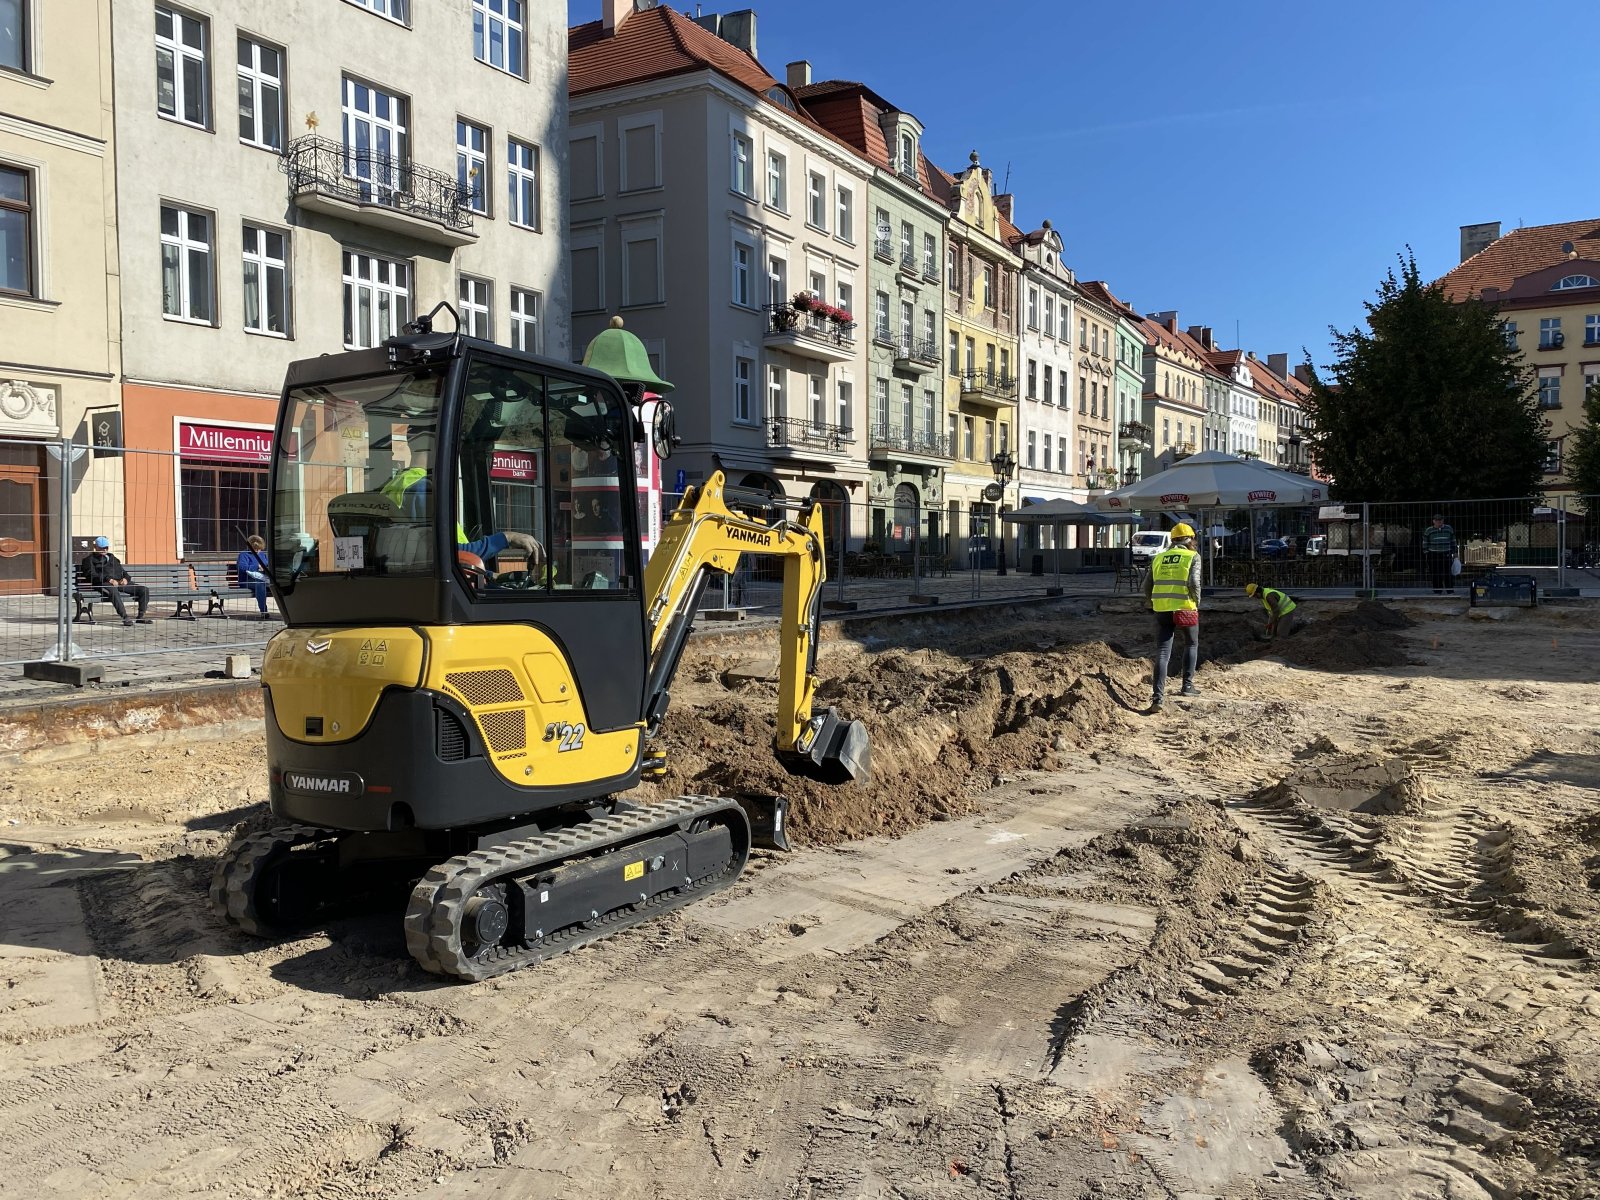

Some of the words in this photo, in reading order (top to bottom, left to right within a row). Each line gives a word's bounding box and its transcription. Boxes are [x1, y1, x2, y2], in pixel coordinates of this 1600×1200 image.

[187, 425, 272, 452] Millenniu
[493, 456, 532, 470] ennium
[512, 469, 527, 477] bank
[725, 525, 772, 547] YANMAR
[291, 775, 350, 793] YANMAR
